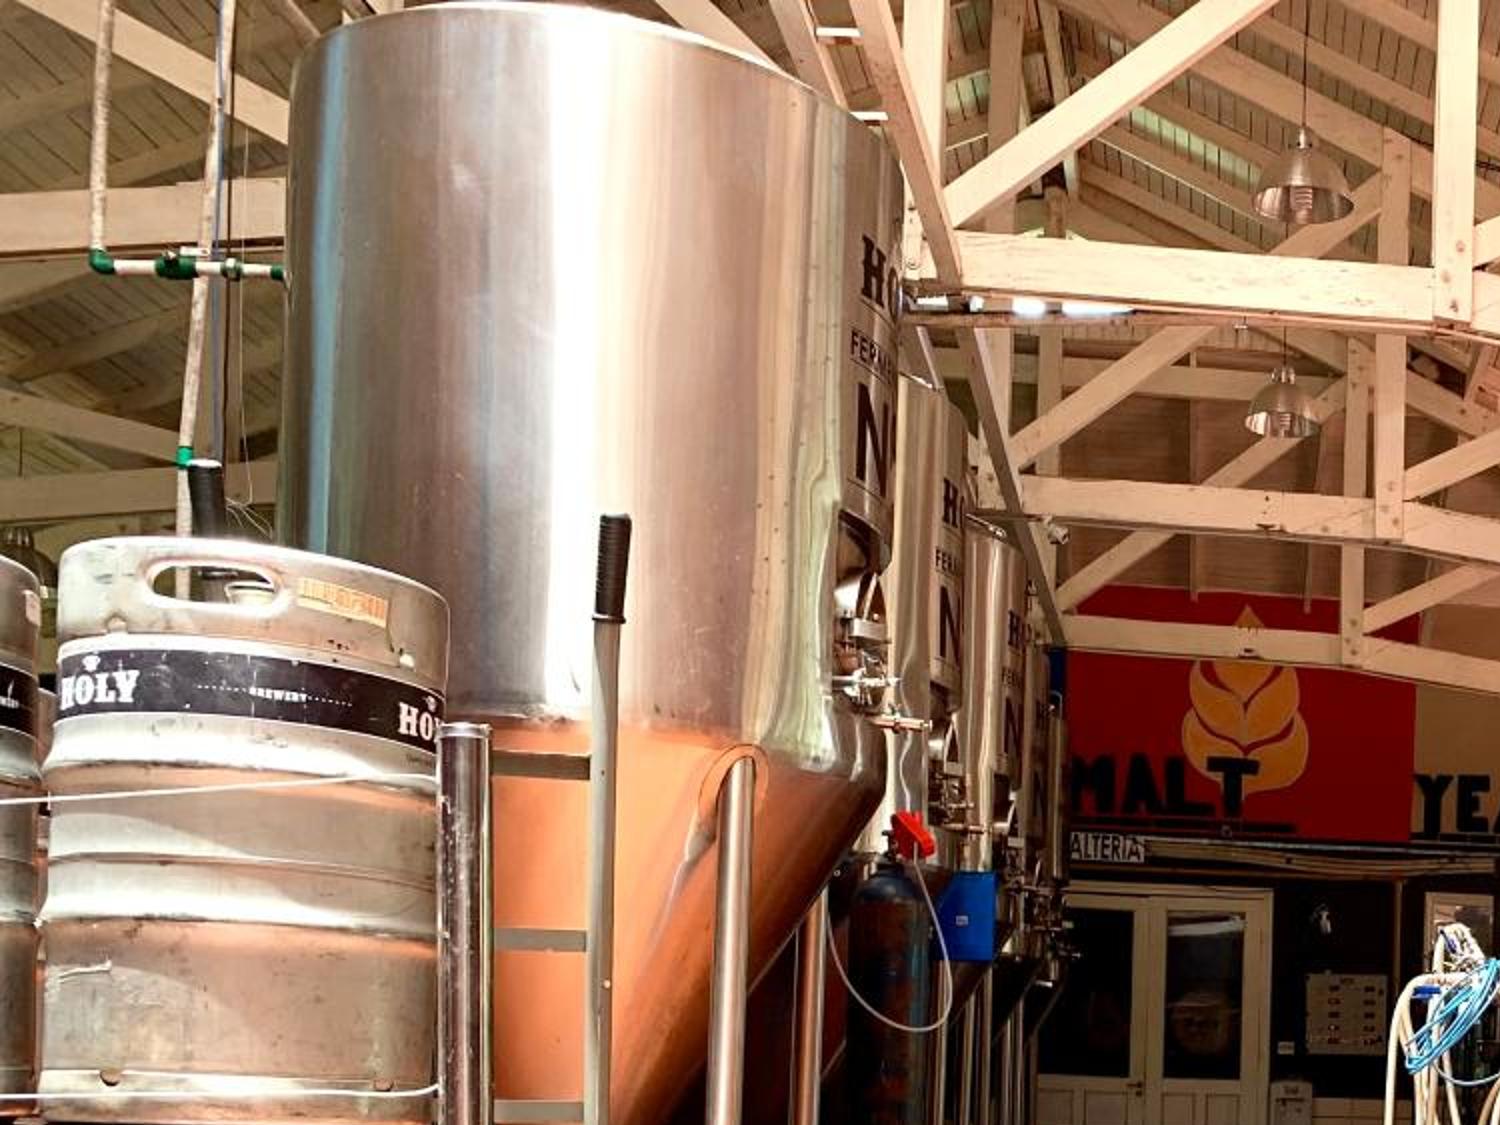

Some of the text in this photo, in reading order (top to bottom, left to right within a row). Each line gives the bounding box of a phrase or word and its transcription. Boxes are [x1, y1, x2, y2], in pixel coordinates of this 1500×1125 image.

[60, 669, 140, 710] HOLY
[398, 701, 443, 742] HO
[1071, 754, 1260, 818] MALT
